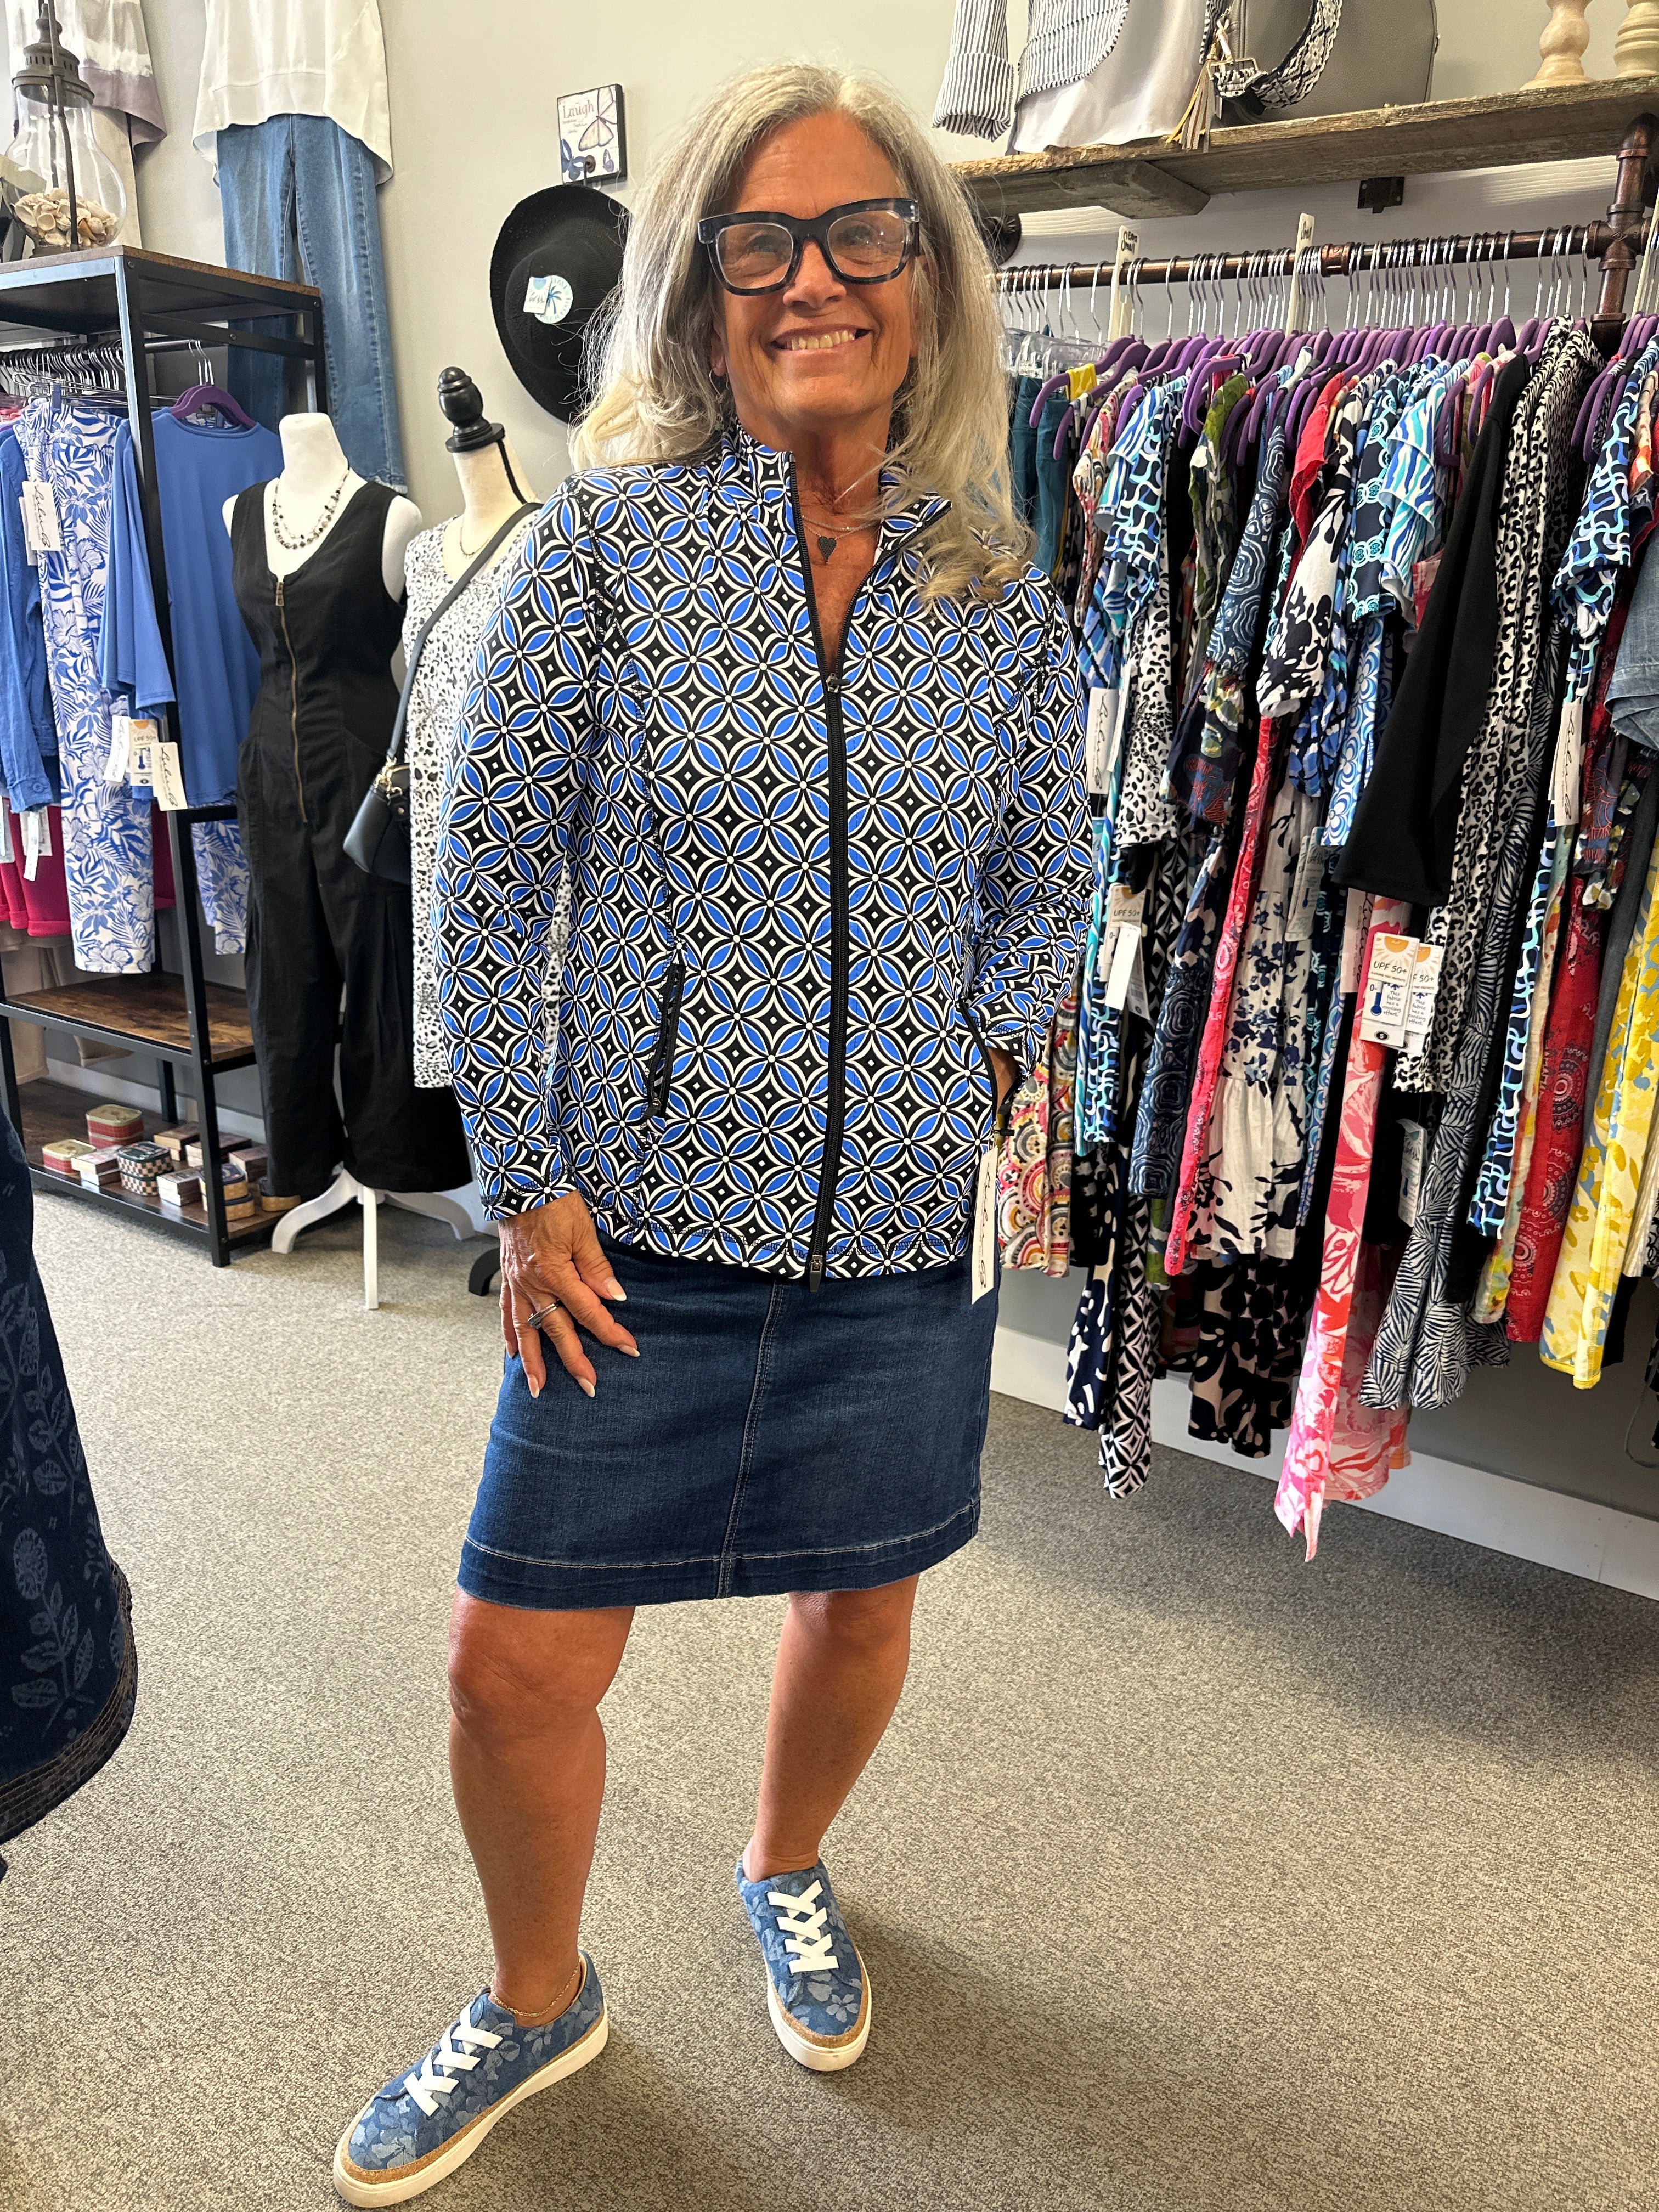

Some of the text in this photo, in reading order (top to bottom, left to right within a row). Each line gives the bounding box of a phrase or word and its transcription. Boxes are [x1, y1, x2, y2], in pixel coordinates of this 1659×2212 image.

[562, 99, 594, 119] Laugh
[1373, 961, 1408, 974] UPF 50+
[1419, 974, 1434, 983] 50+
[1382, 1005, 1401, 1013] cooling
[1408, 1014, 1426, 1022] cooling
